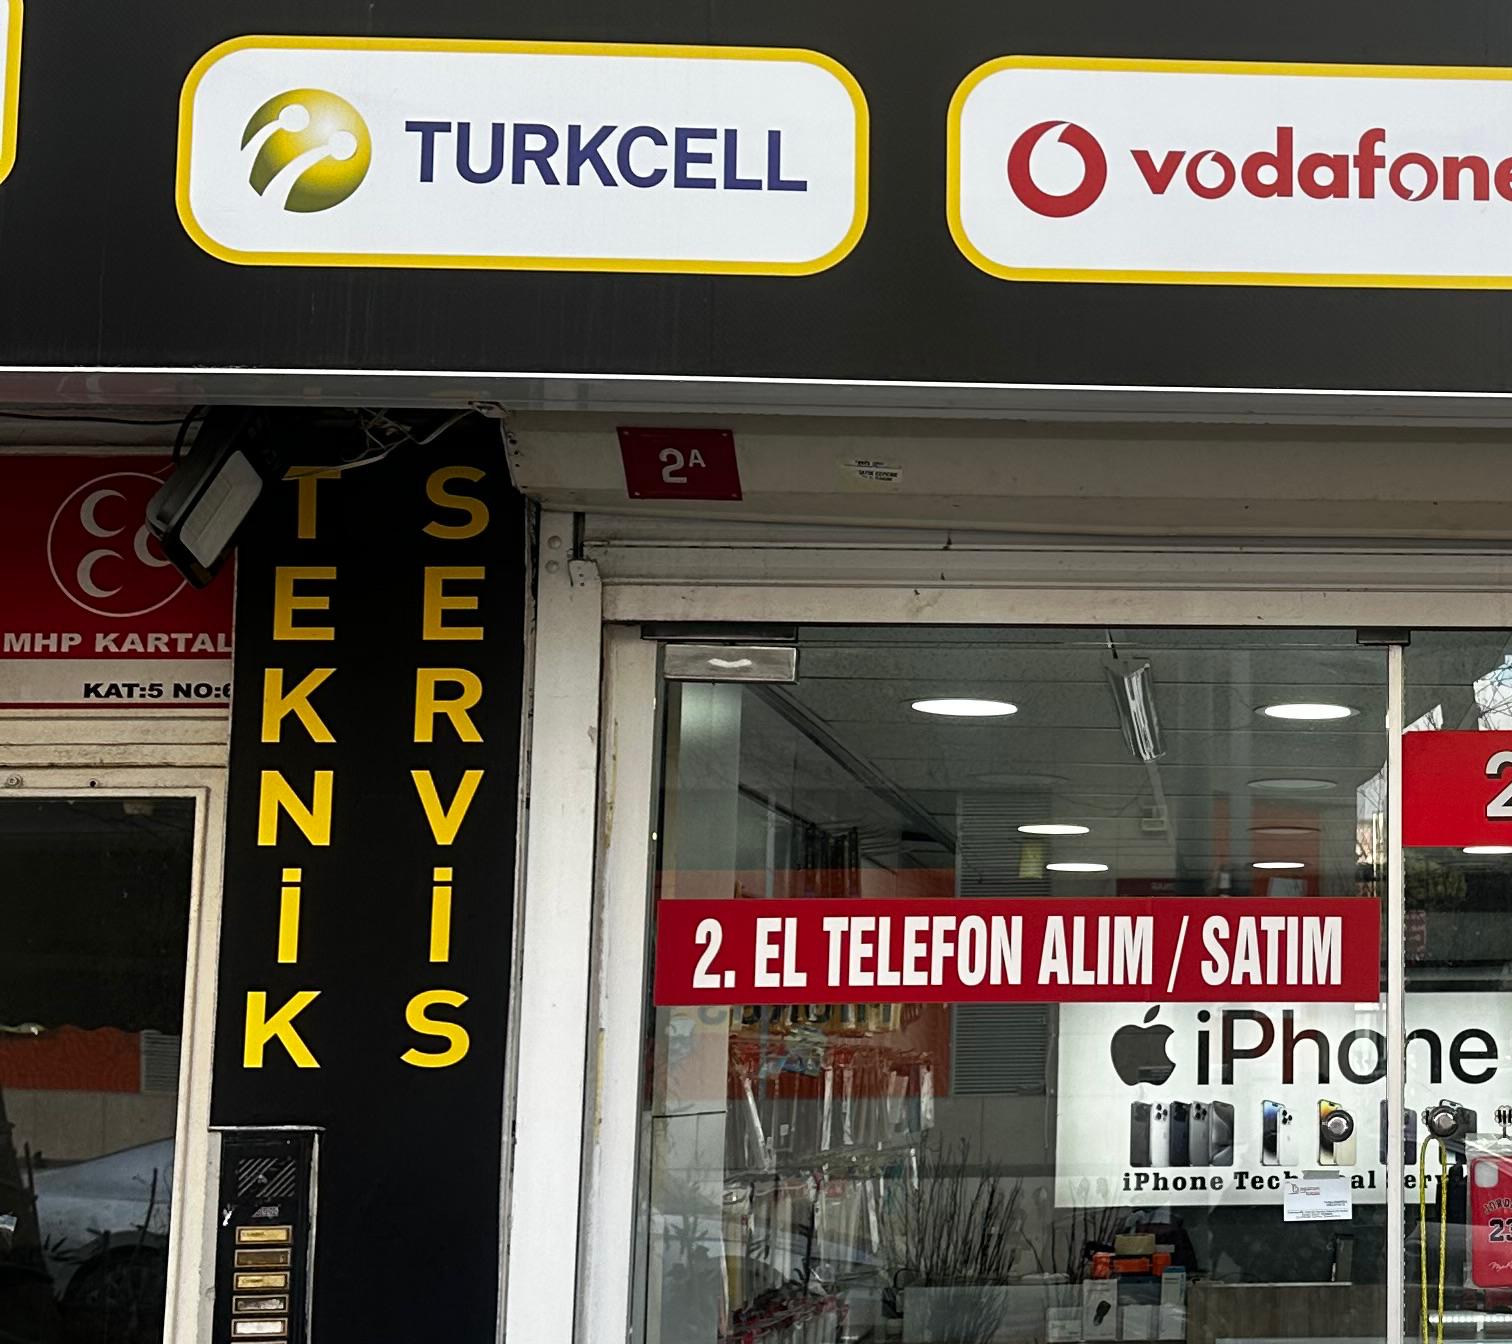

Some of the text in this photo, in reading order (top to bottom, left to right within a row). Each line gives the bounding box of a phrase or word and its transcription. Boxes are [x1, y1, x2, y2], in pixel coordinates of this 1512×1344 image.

[404, 119, 808, 194] TURKCELL
[3, 632, 233, 653] MHP KARTAL
[83, 682, 163, 699] KAT:5
[692, 917, 736, 989] 2.
[754, 916, 807, 987] EL
[822, 916, 1023, 987] TELEFON
[1038, 915, 1154, 986] ALIM
[1201, 915, 1343, 986] SATIM
[1197, 1009, 1499, 1086] iPhone
[1123, 1173, 1224, 1192] iPhone
